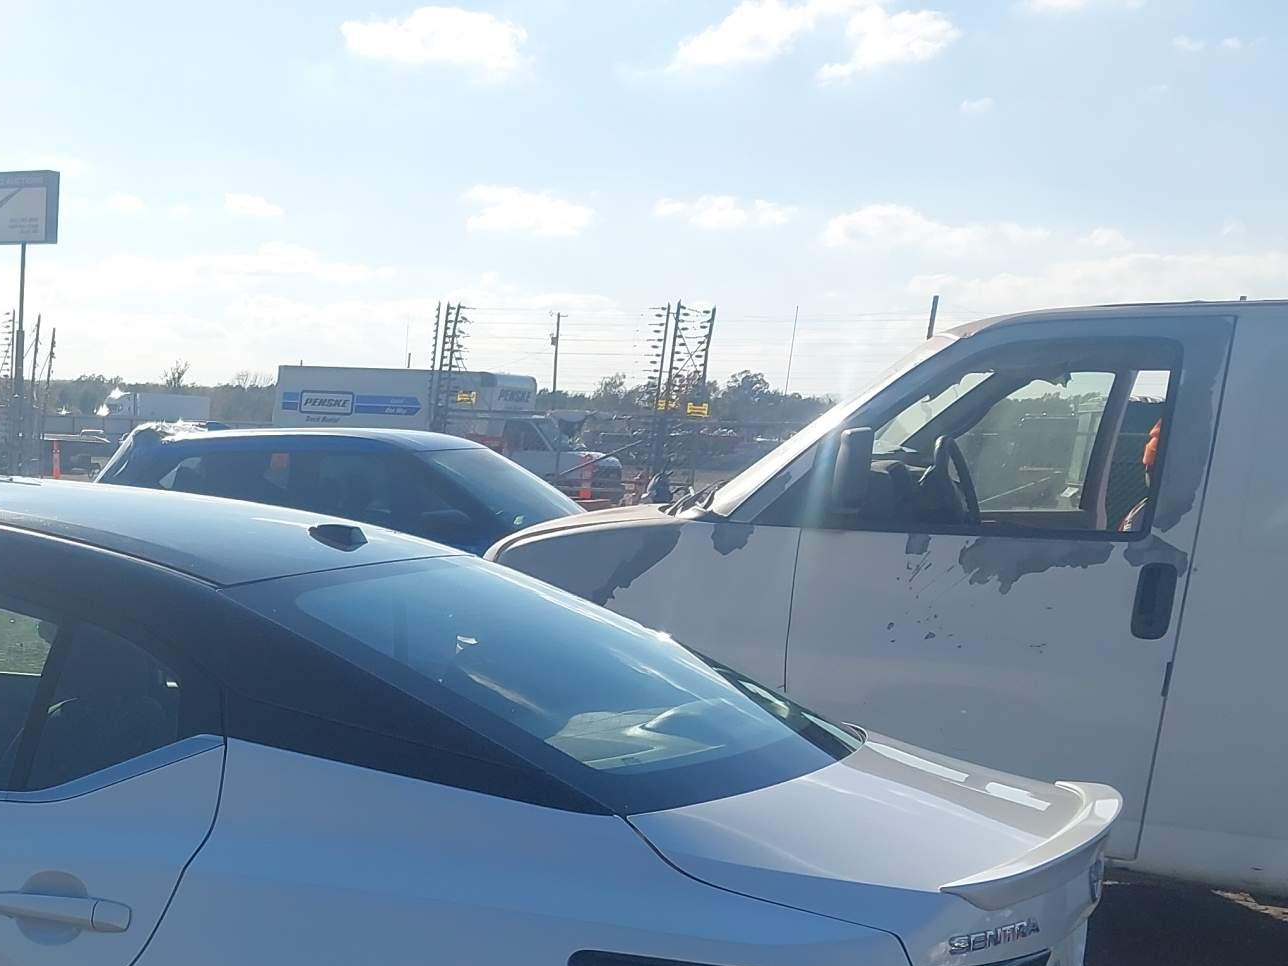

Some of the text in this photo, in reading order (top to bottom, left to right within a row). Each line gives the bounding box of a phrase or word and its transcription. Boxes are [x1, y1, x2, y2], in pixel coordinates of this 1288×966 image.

[497, 389, 531, 402] PENSKE
[303, 397, 350, 408] PENSKE
[949, 917, 1040, 955] SENTRA
